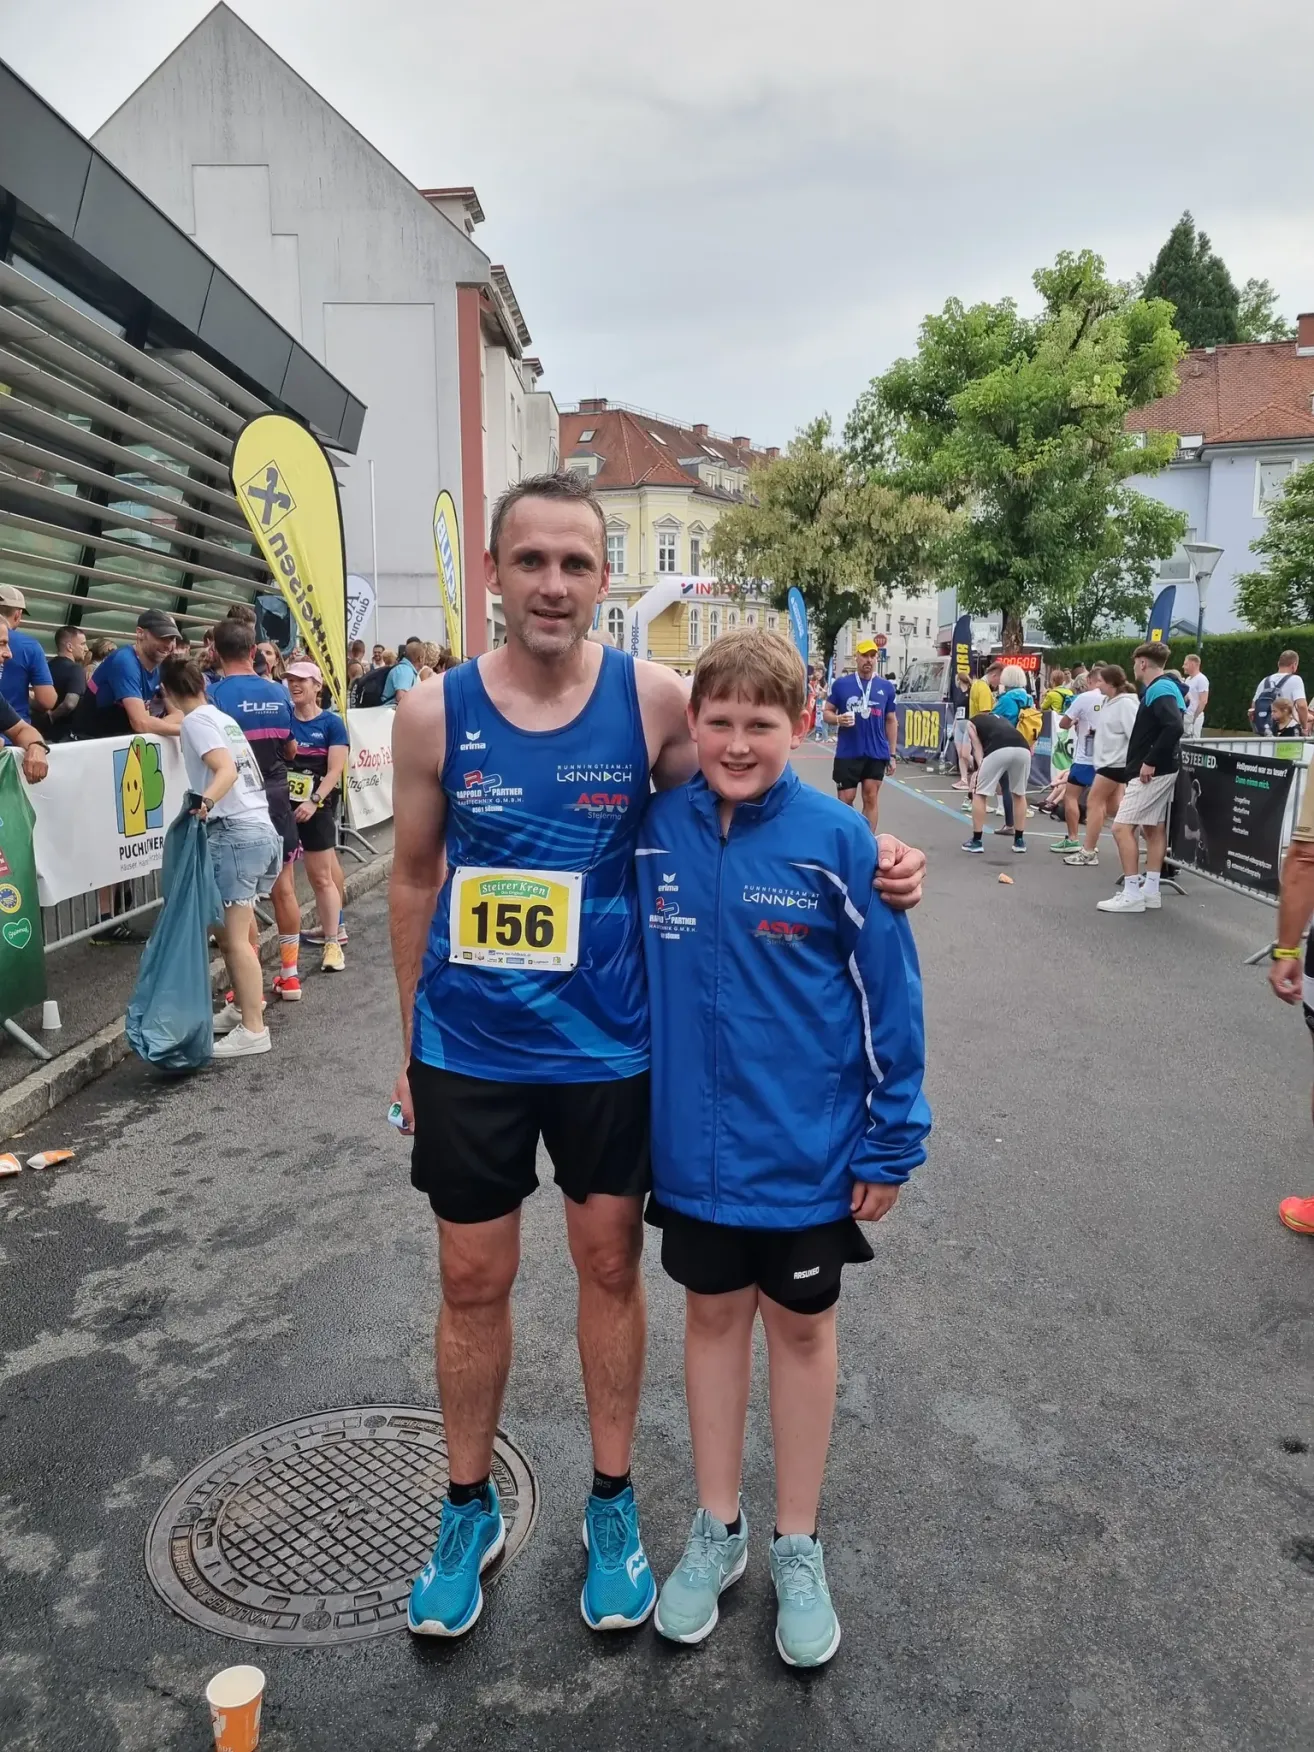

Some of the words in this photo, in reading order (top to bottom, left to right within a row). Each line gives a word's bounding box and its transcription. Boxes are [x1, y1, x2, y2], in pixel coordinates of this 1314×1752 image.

[349, 597, 370, 641] runclub
[237, 700, 284, 713] tus
[460, 741, 486, 750] erima
[358, 749, 380, 771] Shop
[1236, 762, 1258, 773] Hollywood
[492, 787, 523, 797] PARTNER
[482, 882, 518, 894] Steirer
[520, 882, 546, 896] Kren
[471, 901, 554, 948] 156
[671, 916, 697, 926] PARTNER
[207, 1595, 269, 1625] WALLNER
